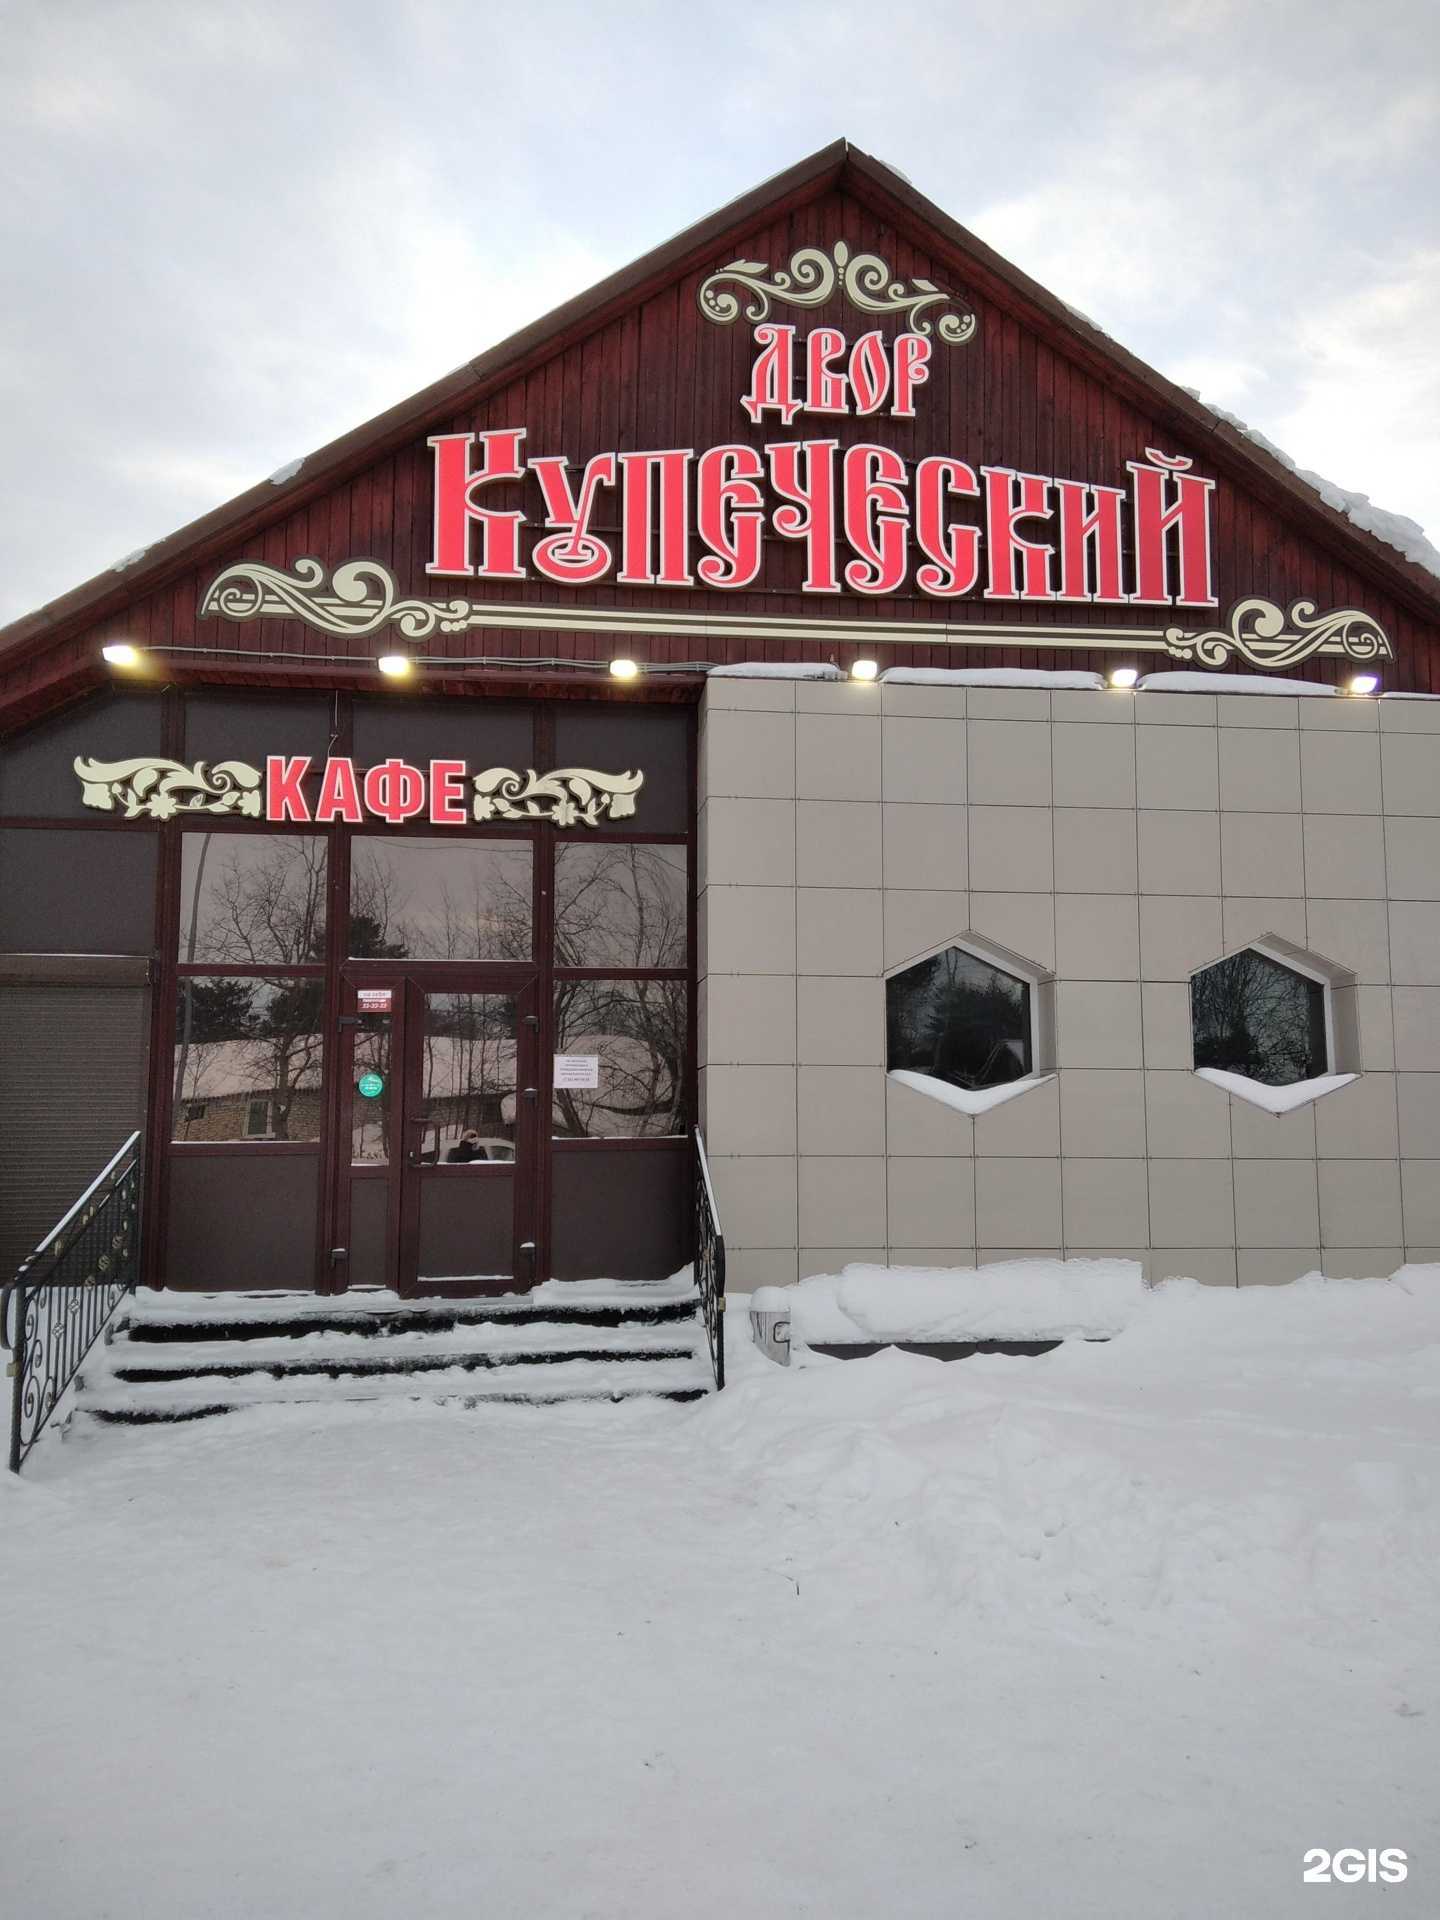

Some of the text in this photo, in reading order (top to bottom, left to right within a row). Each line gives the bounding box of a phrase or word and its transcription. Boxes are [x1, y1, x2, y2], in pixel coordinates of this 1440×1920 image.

[741, 323, 932, 424] ДВОР
[425, 427, 1219, 607] КУПЕЧЕСКИЙ
[266, 755, 467, 824] КАФЕ
